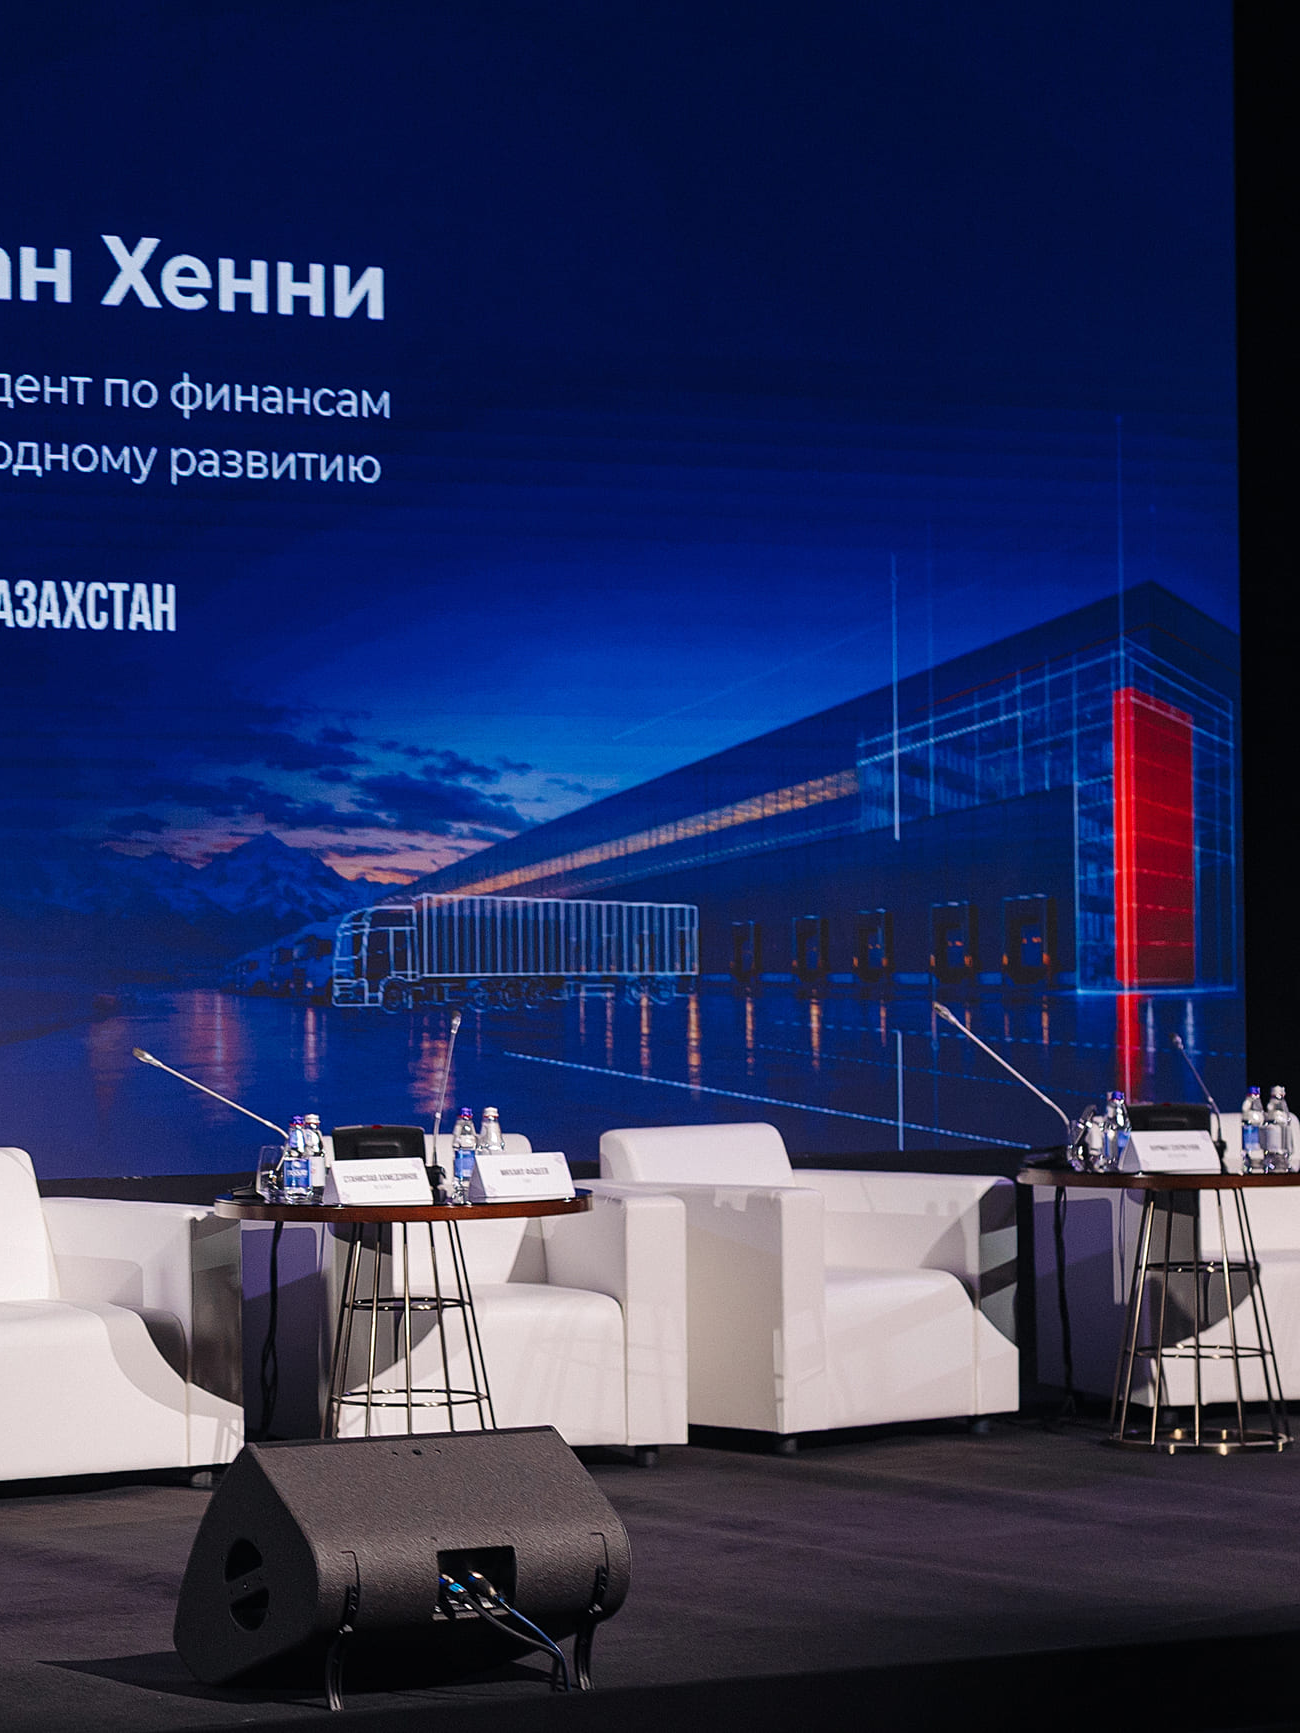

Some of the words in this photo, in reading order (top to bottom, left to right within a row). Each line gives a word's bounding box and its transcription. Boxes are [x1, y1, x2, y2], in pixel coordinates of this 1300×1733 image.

[100, 234, 386, 321] Хенни
[104, 377, 159, 409] по
[170, 371, 392, 420] финансам
[170, 447, 382, 485] развитию
